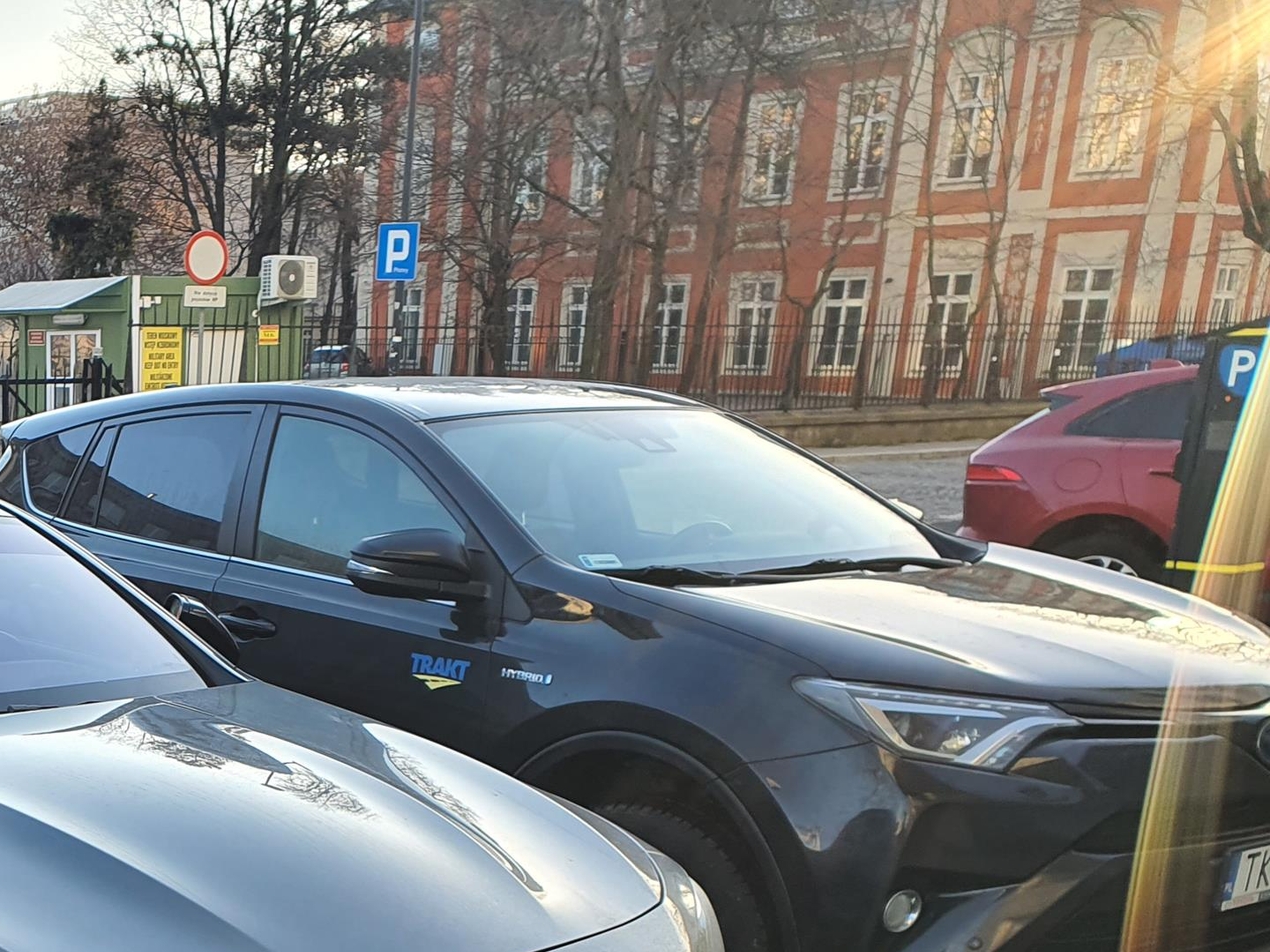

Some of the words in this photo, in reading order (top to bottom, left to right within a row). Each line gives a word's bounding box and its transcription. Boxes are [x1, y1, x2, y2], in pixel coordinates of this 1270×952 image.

[385, 229, 410, 273] P
[1227, 349, 1256, 387] P
[411, 653, 471, 681] TRAKT
[501, 668, 544, 684] HYBRID
